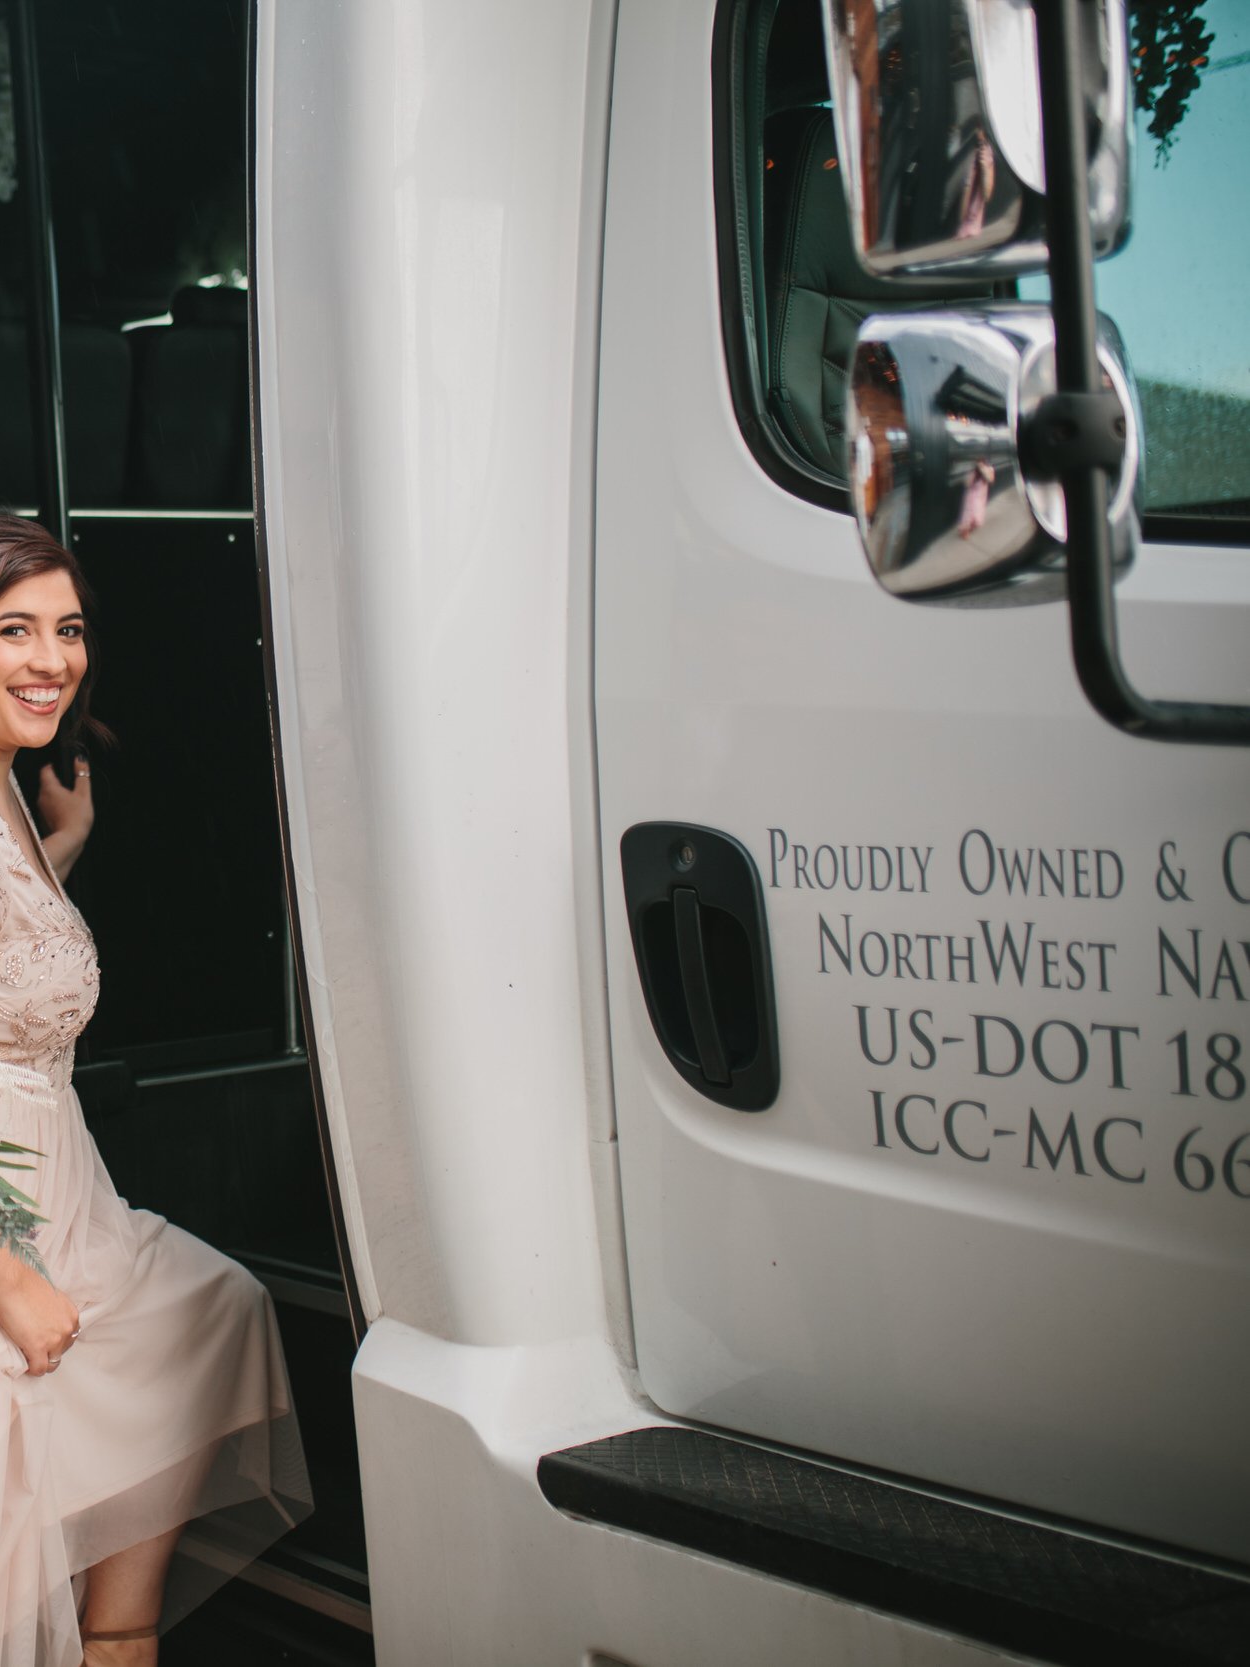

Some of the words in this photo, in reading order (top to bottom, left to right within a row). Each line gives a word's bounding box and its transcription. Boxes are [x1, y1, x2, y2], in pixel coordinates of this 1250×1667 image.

[1155, 840, 1194, 902] &
[852, 1004, 1140, 1090] US-DOT
[1165, 1030, 1248, 1102] 18
[868, 1089, 1146, 1184] ICC-MC
